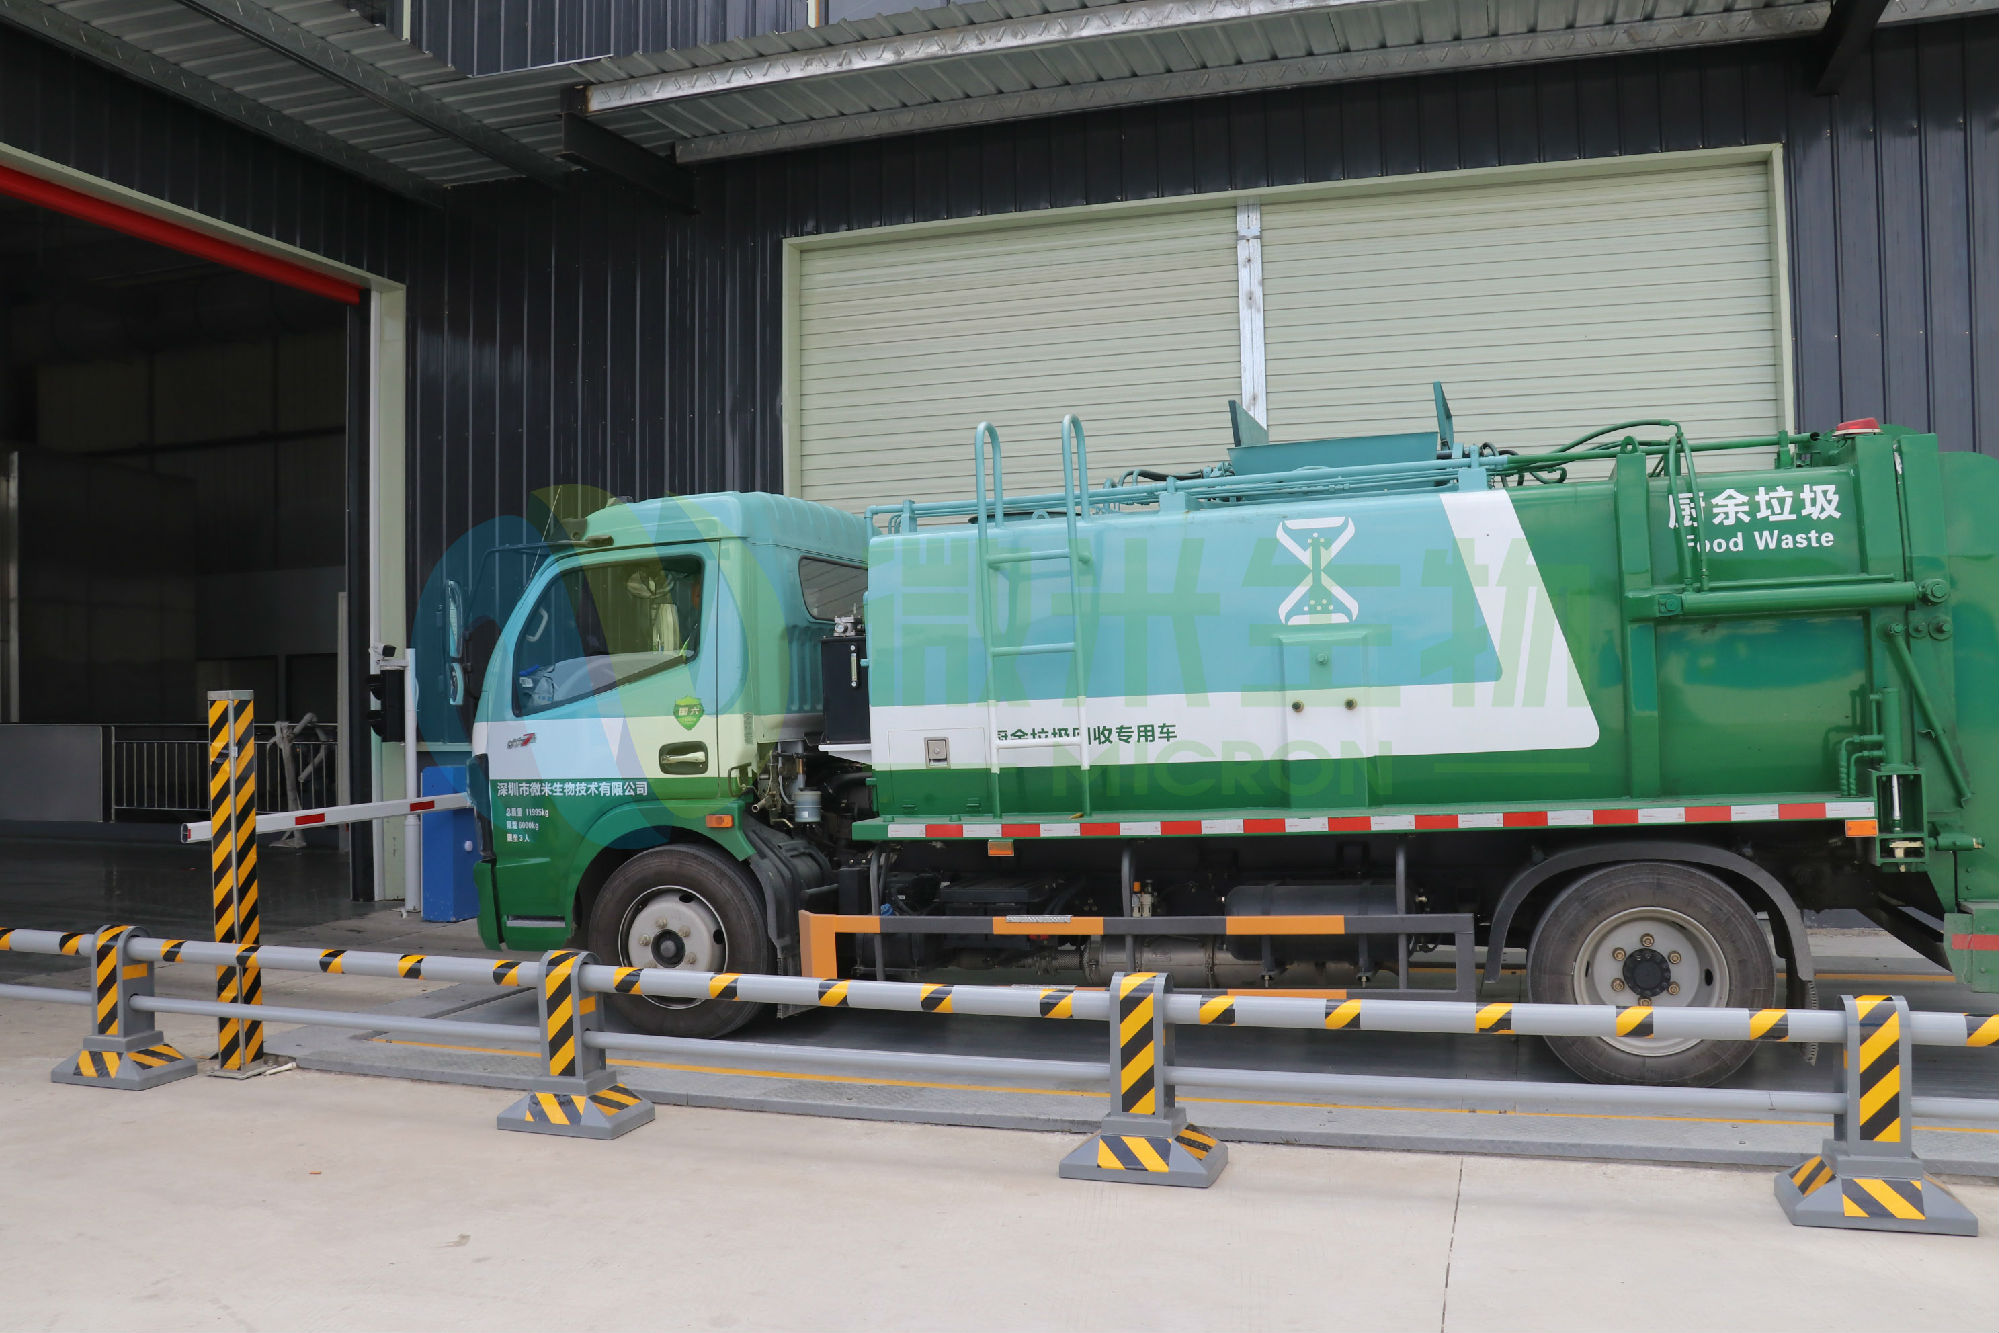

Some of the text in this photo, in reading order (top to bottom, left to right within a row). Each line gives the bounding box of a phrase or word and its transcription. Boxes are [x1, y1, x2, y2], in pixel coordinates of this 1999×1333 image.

[1753, 529, 1835, 550] Waste
[496, 780, 649, 798] 深圳市微米生物技术有限公司
